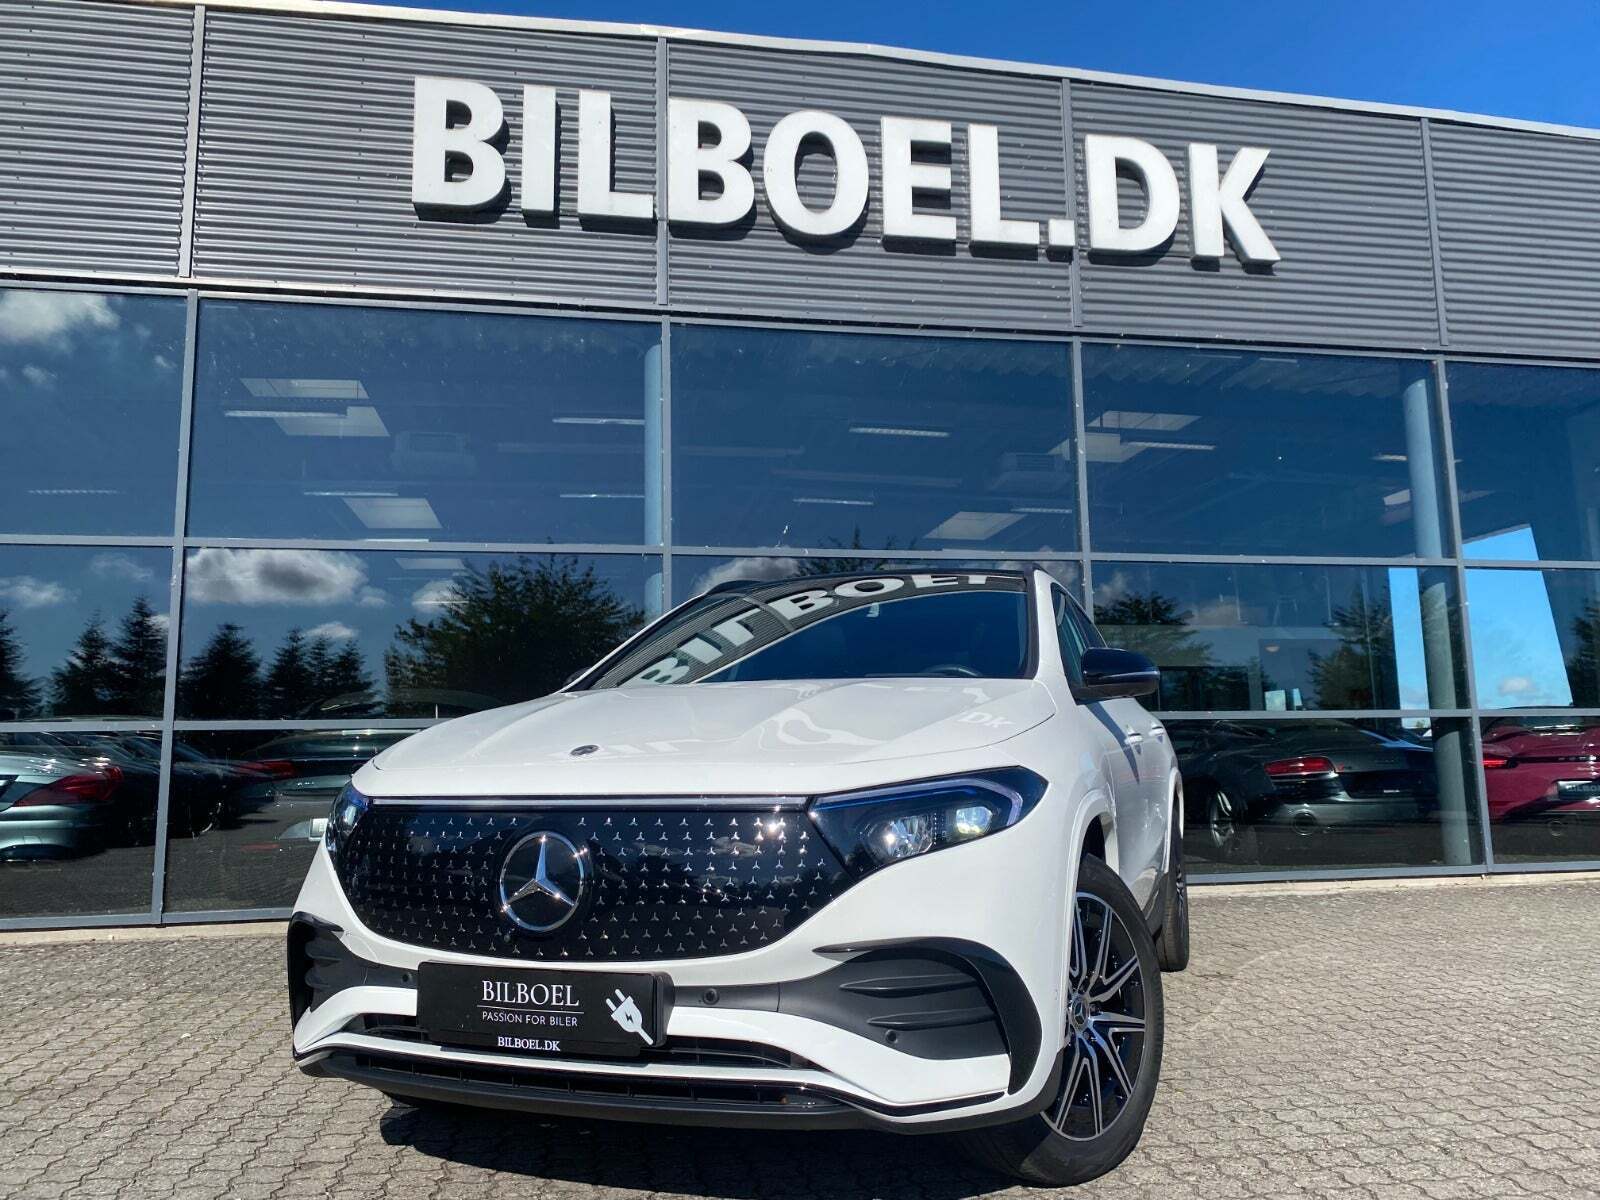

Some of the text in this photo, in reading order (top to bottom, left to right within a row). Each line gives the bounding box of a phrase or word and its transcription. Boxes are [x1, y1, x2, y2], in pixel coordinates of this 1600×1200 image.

[412, 76, 1280, 267] BILBOEL.DK
[481, 980, 580, 1006] BILBOEL
[482, 1011, 578, 1027] PASSION FOR BILER
[497, 1036, 561, 1051] BILBOEL.DK
